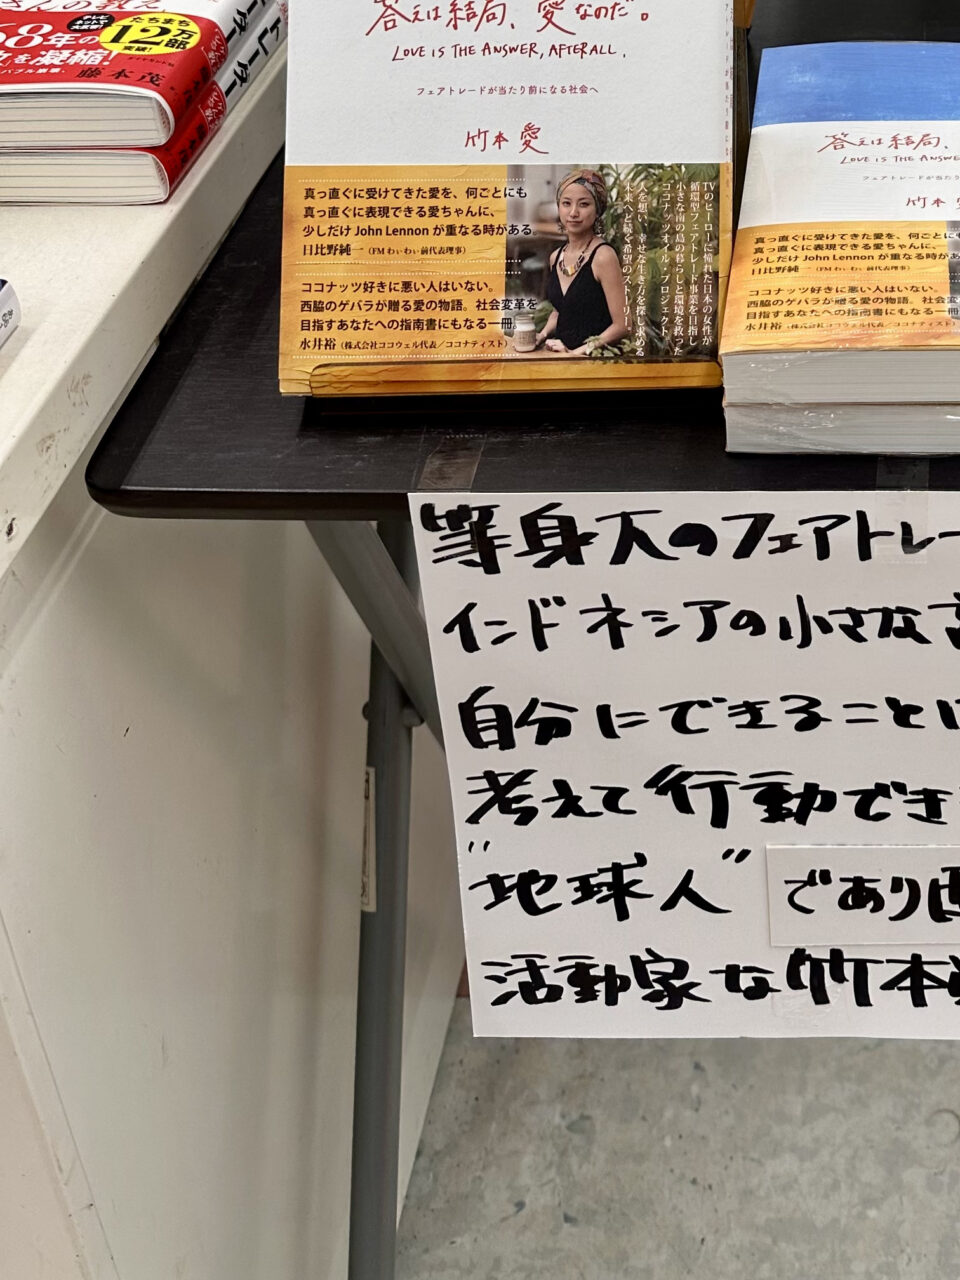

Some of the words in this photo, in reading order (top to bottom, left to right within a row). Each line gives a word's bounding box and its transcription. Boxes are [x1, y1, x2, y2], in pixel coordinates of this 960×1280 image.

[451, 43, 477, 58] THE
[303, 186, 528, 201] 真っ直ぐに受けてきた愛を、何ごとにも
[303, 205, 496, 220] 真っ直ぐに表現できる愛ちゃんに、
[385, 224, 429, 237] Lennon
